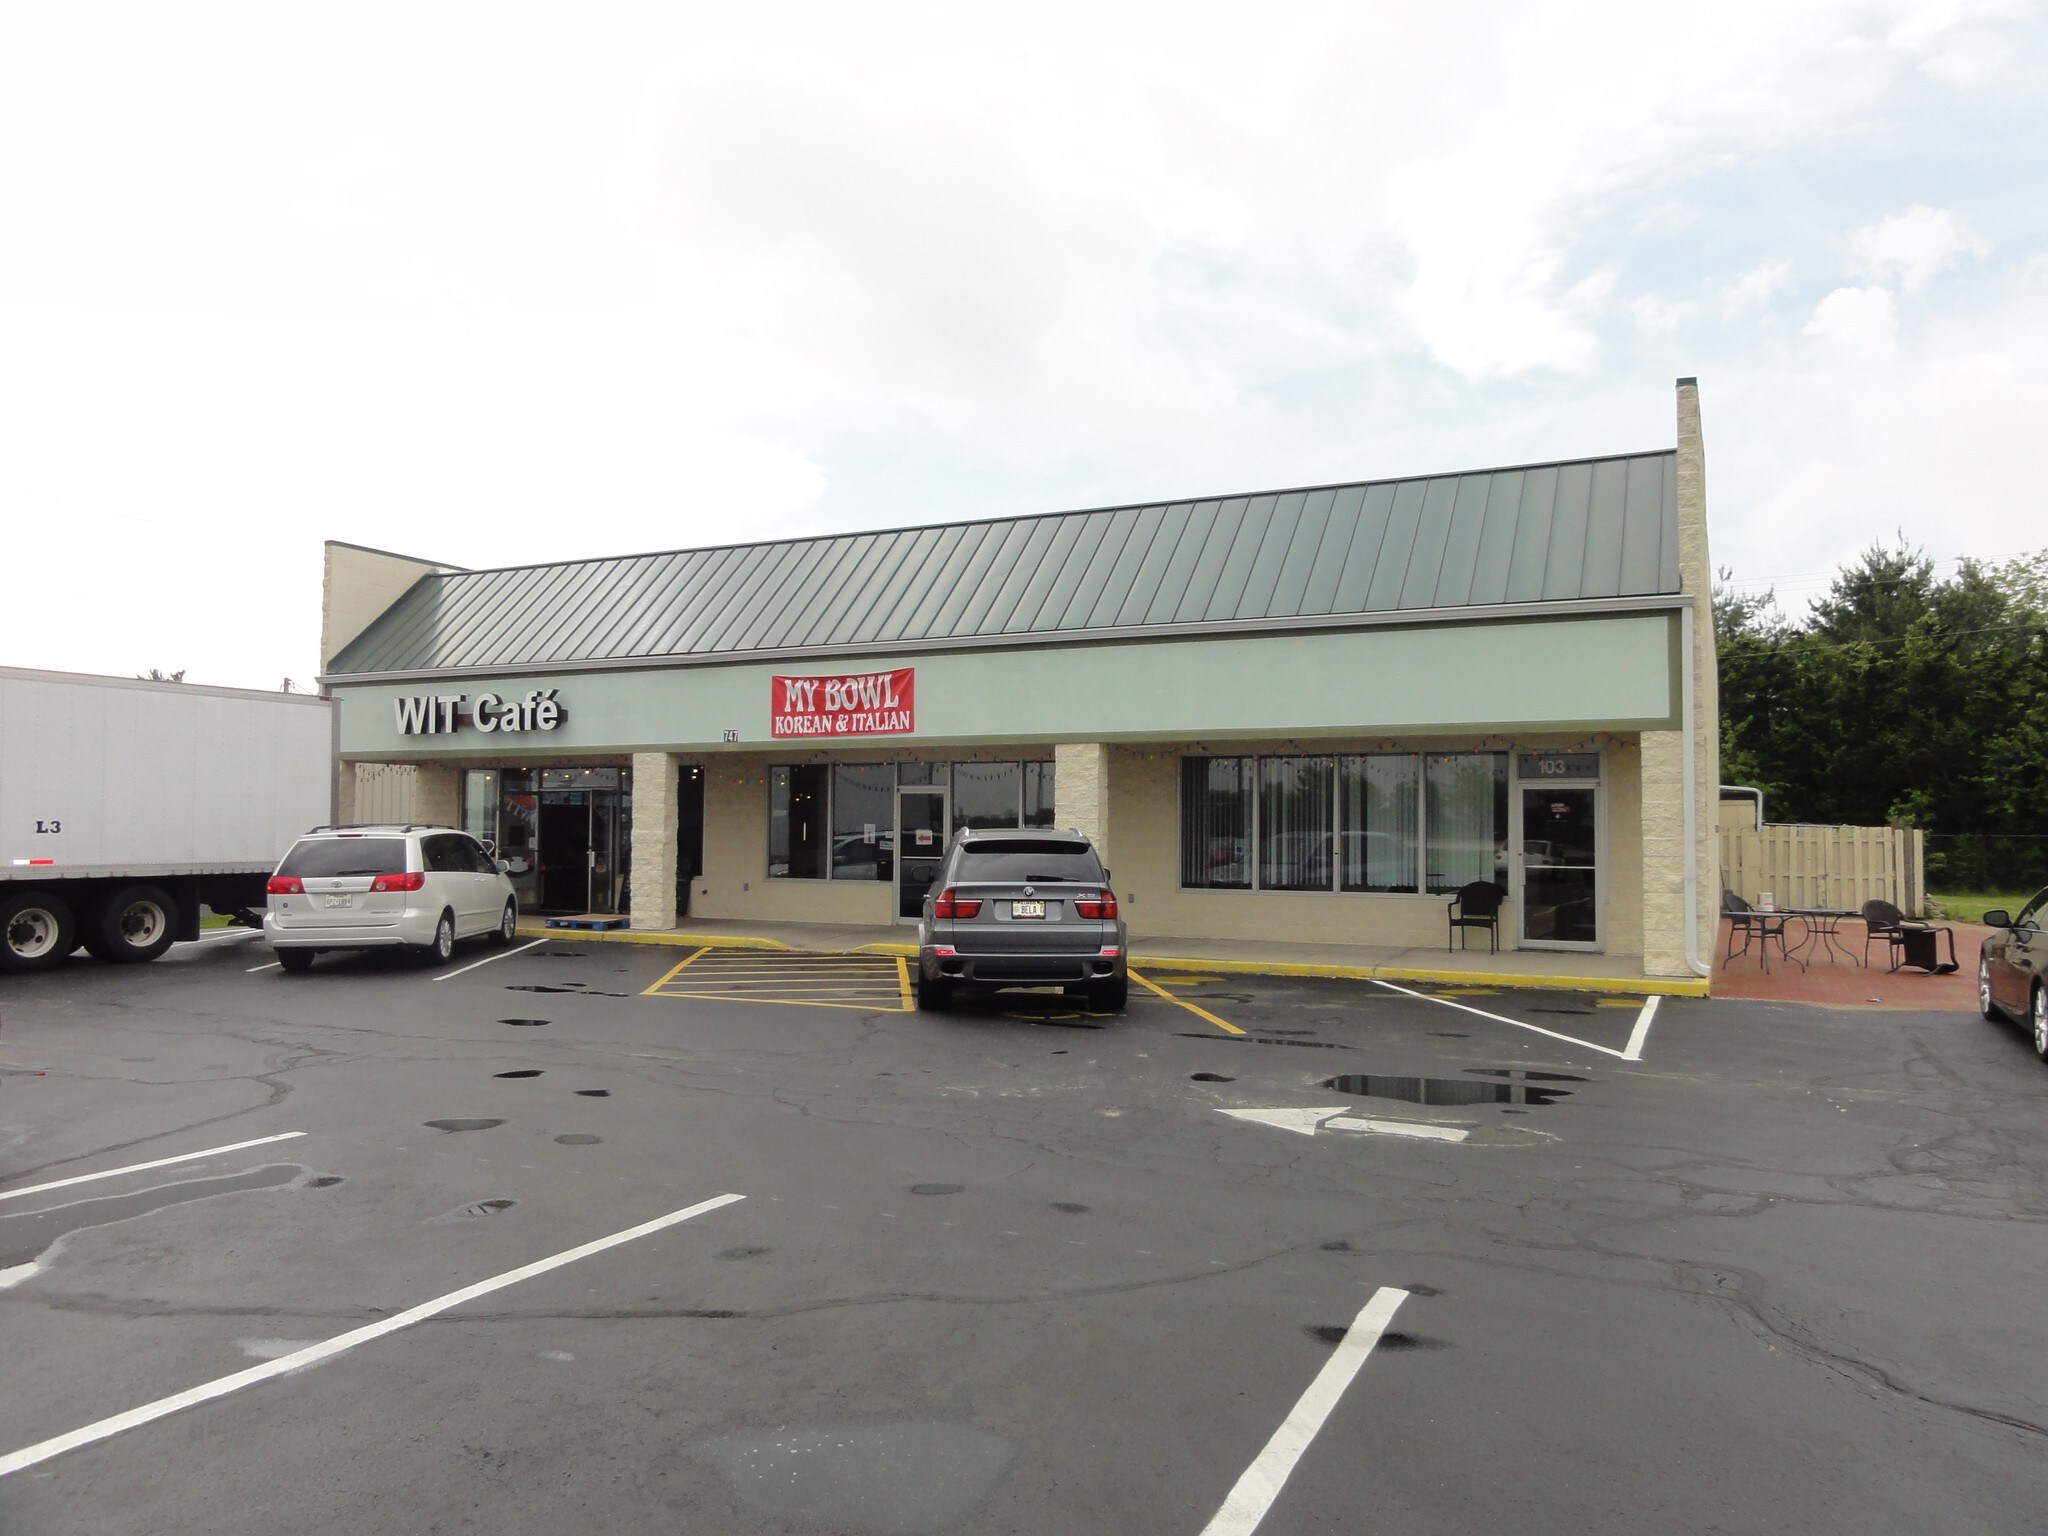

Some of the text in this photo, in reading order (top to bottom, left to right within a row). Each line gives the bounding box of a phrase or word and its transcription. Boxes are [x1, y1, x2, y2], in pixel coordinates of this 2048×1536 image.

[784, 674, 899, 712] MY BOWL
[393, 689, 562, 735] WIT Café
[775, 710, 910, 734] KOREAN & ITALIAN
[724, 730, 738, 742] 747
[1539, 760, 1565, 774] 103
[36, 820, 62, 834] L3
